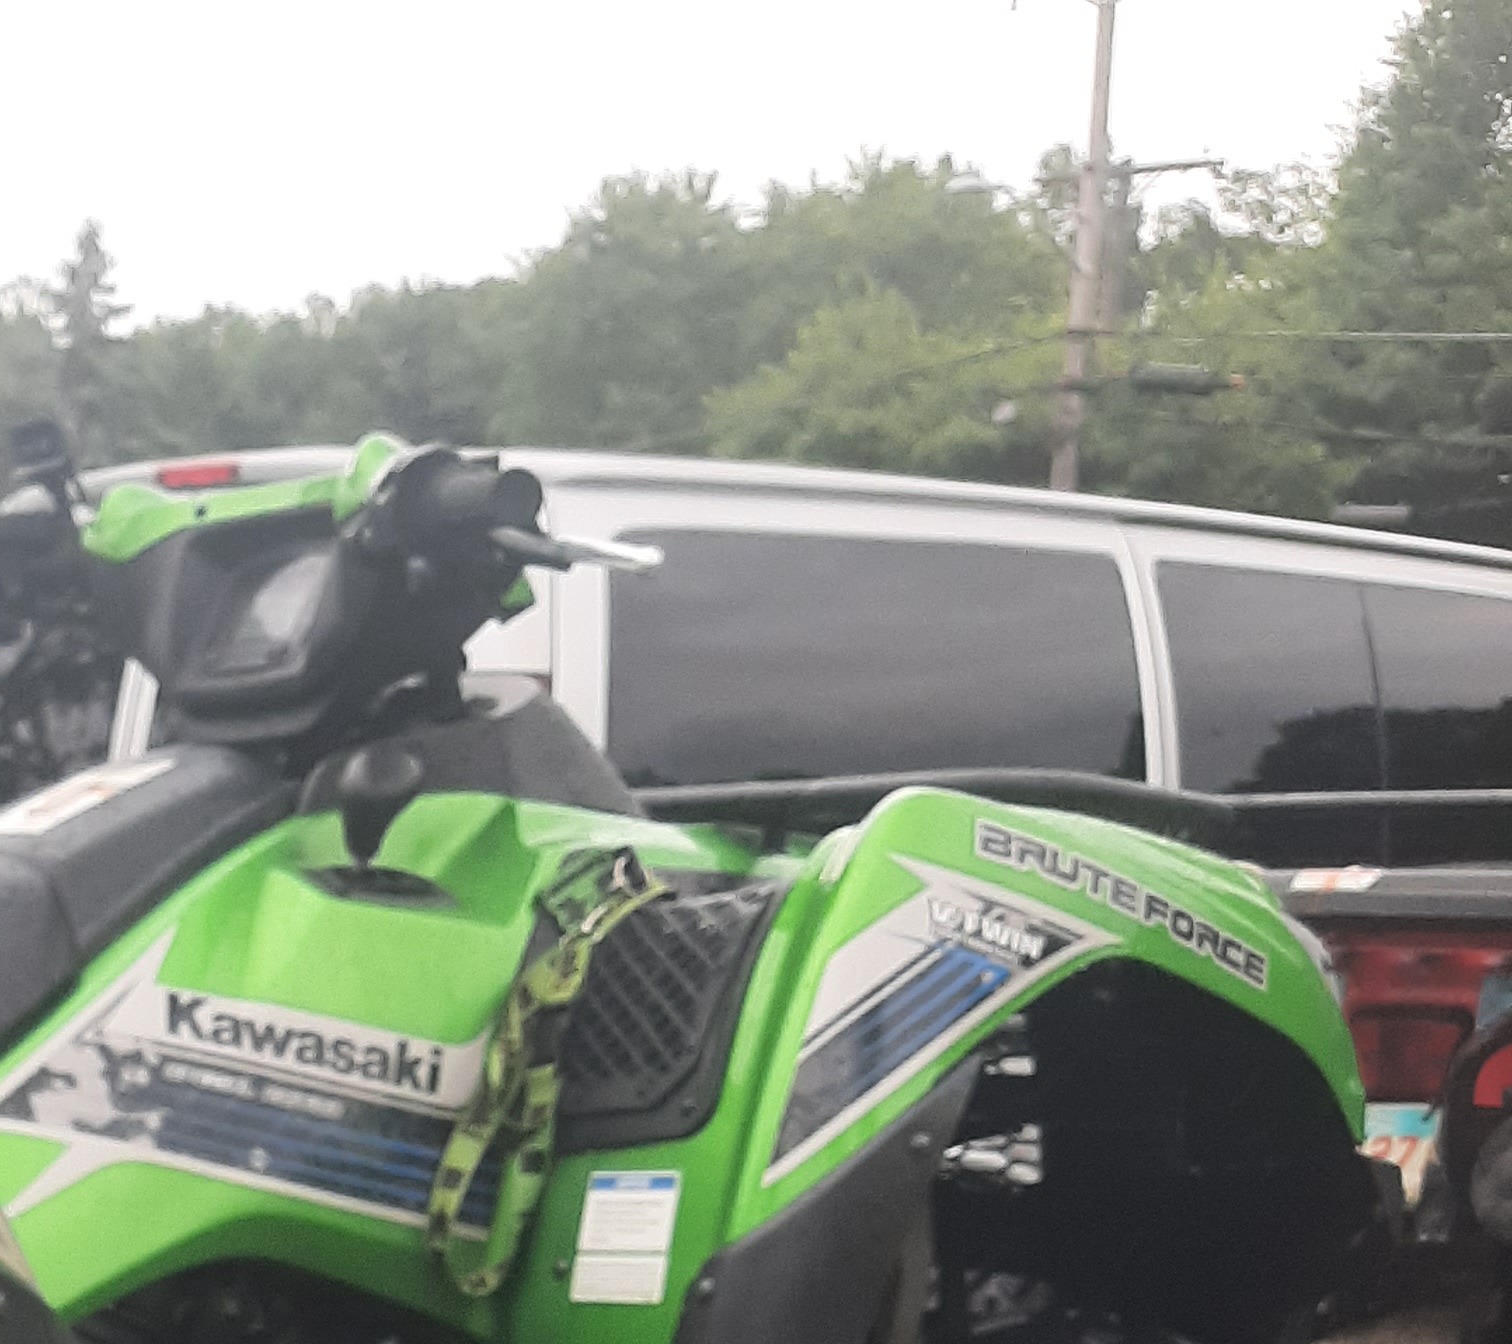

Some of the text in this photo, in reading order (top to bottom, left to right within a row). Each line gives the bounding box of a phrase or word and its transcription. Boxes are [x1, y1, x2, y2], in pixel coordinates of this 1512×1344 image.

[977, 822, 1267, 988] BRUTE FORCE
[167, 991, 443, 1093] Kawasaki
